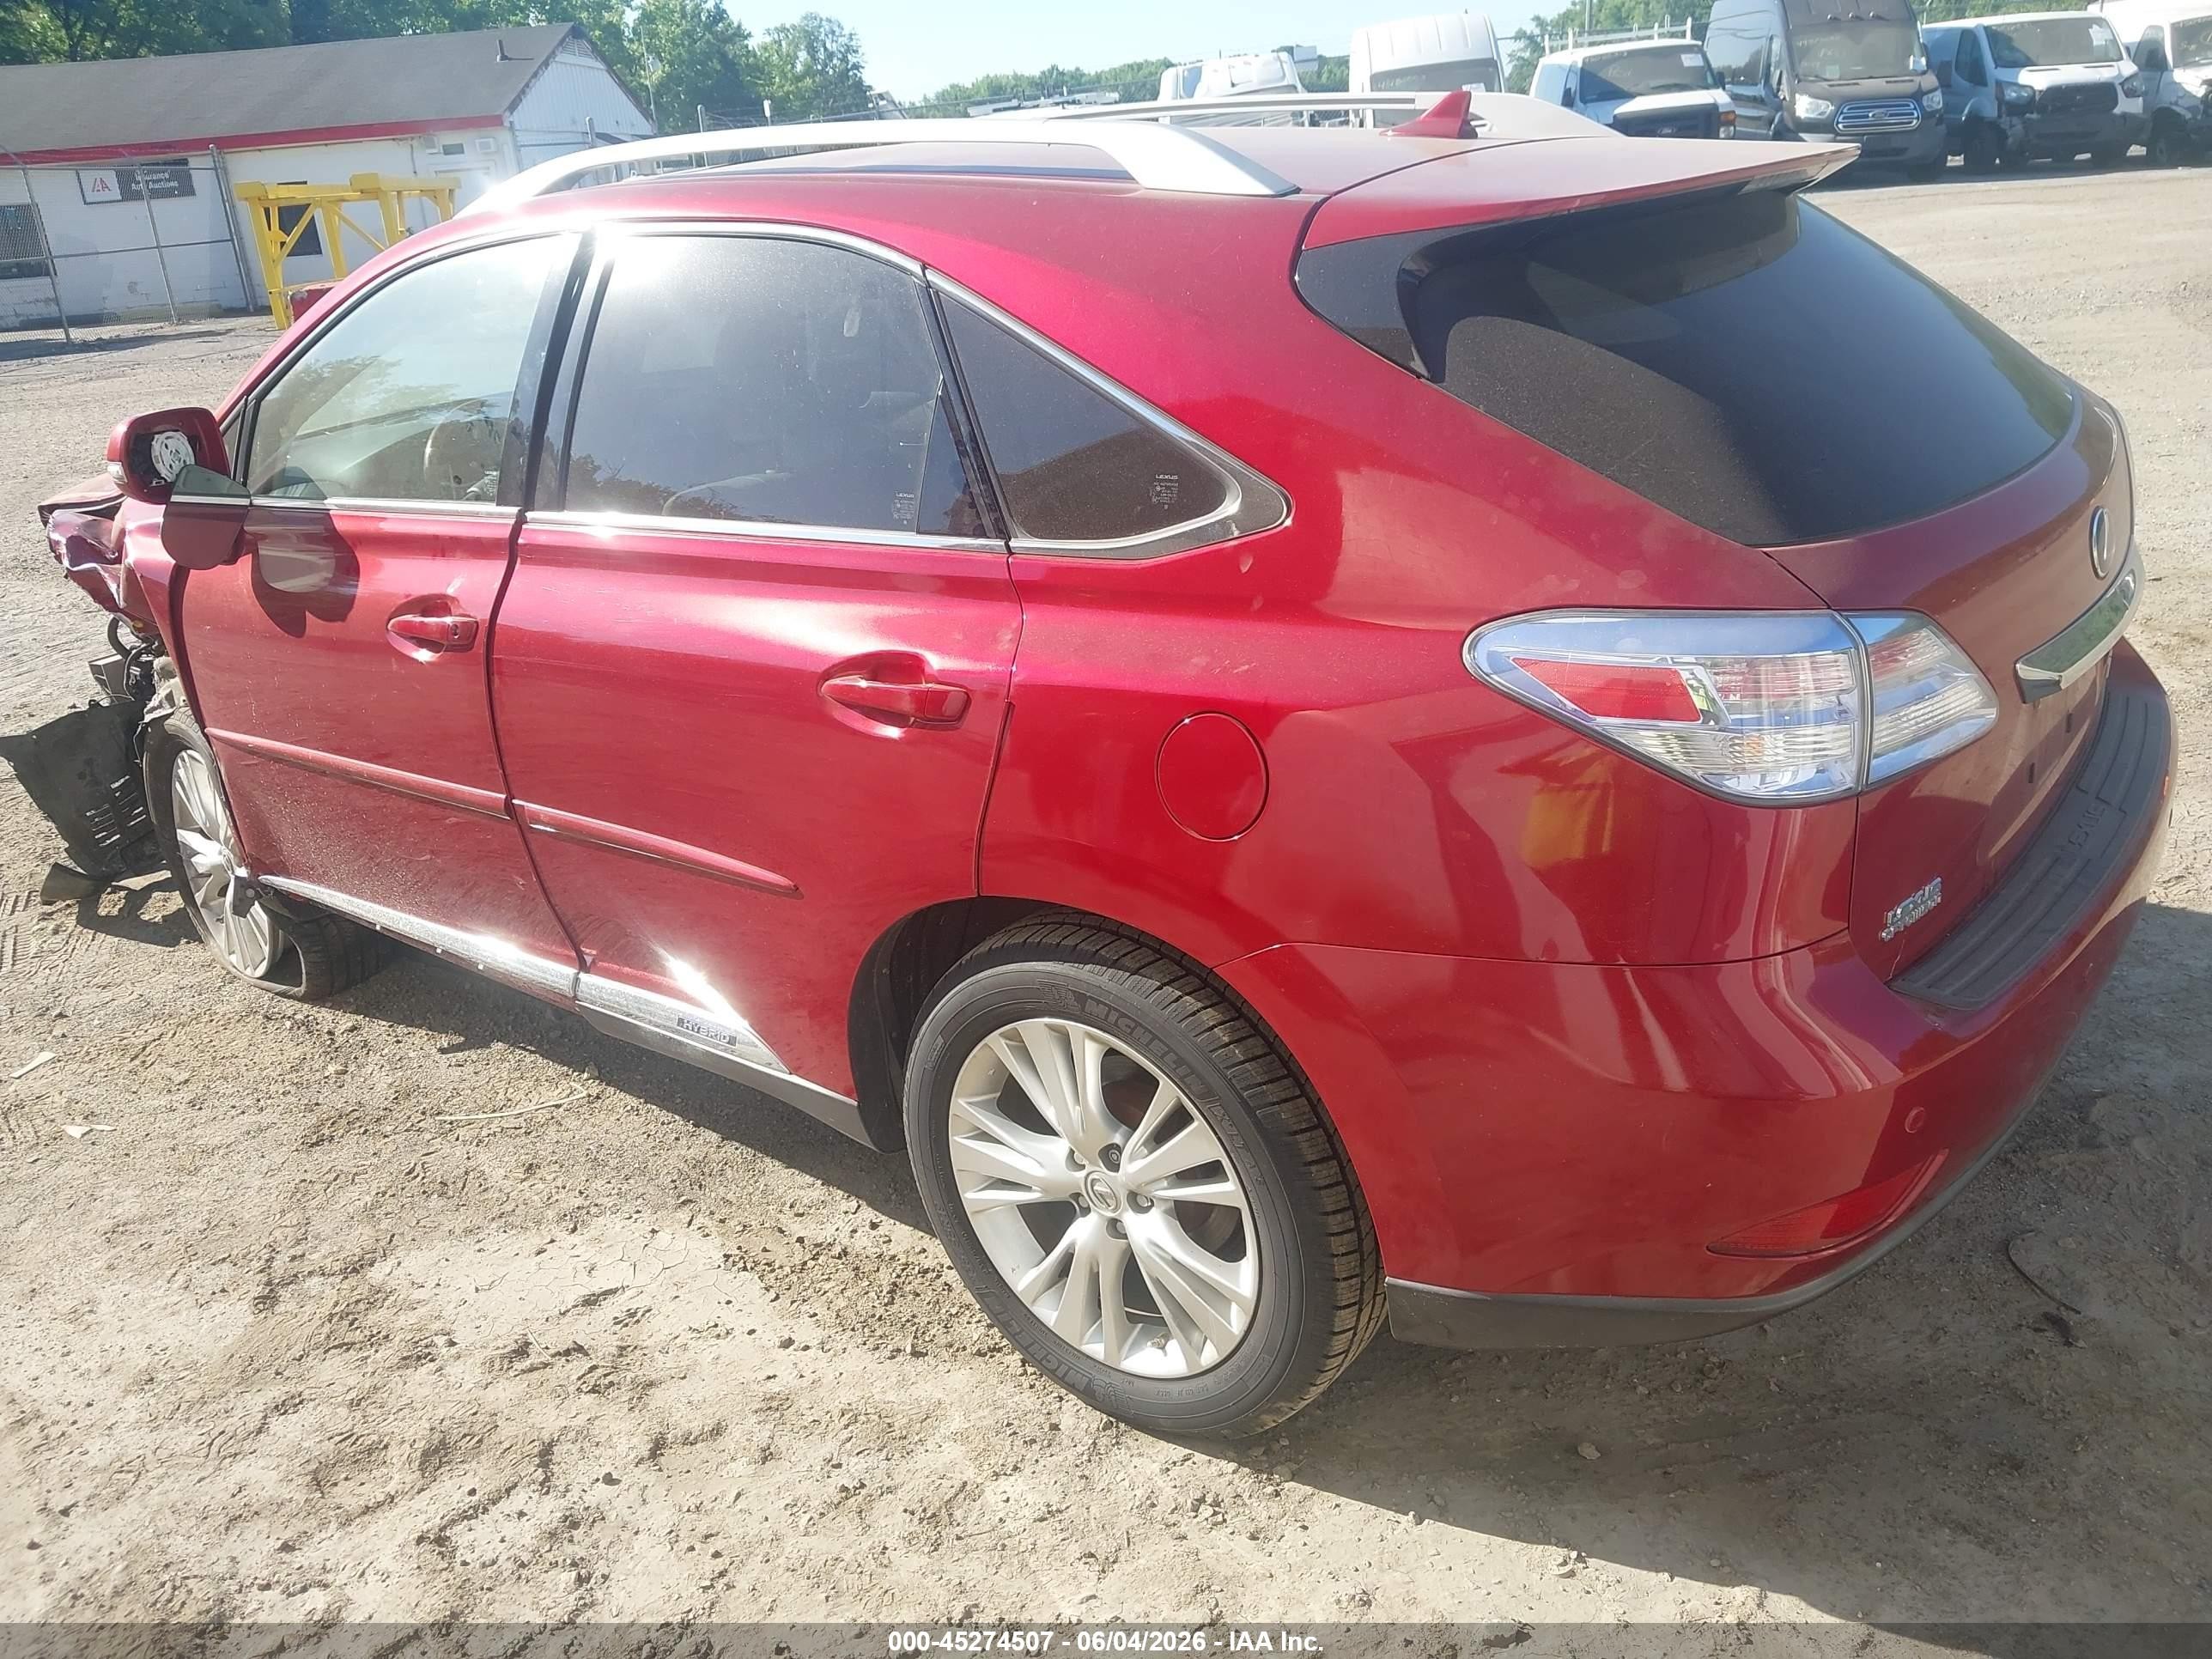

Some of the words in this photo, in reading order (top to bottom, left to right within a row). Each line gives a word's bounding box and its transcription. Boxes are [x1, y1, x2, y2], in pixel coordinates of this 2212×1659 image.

[149, 180, 179, 190] Auctions
[684, 1019, 730, 1043] HYBRID
[1085, 999, 1208, 1101] MICHELIN
